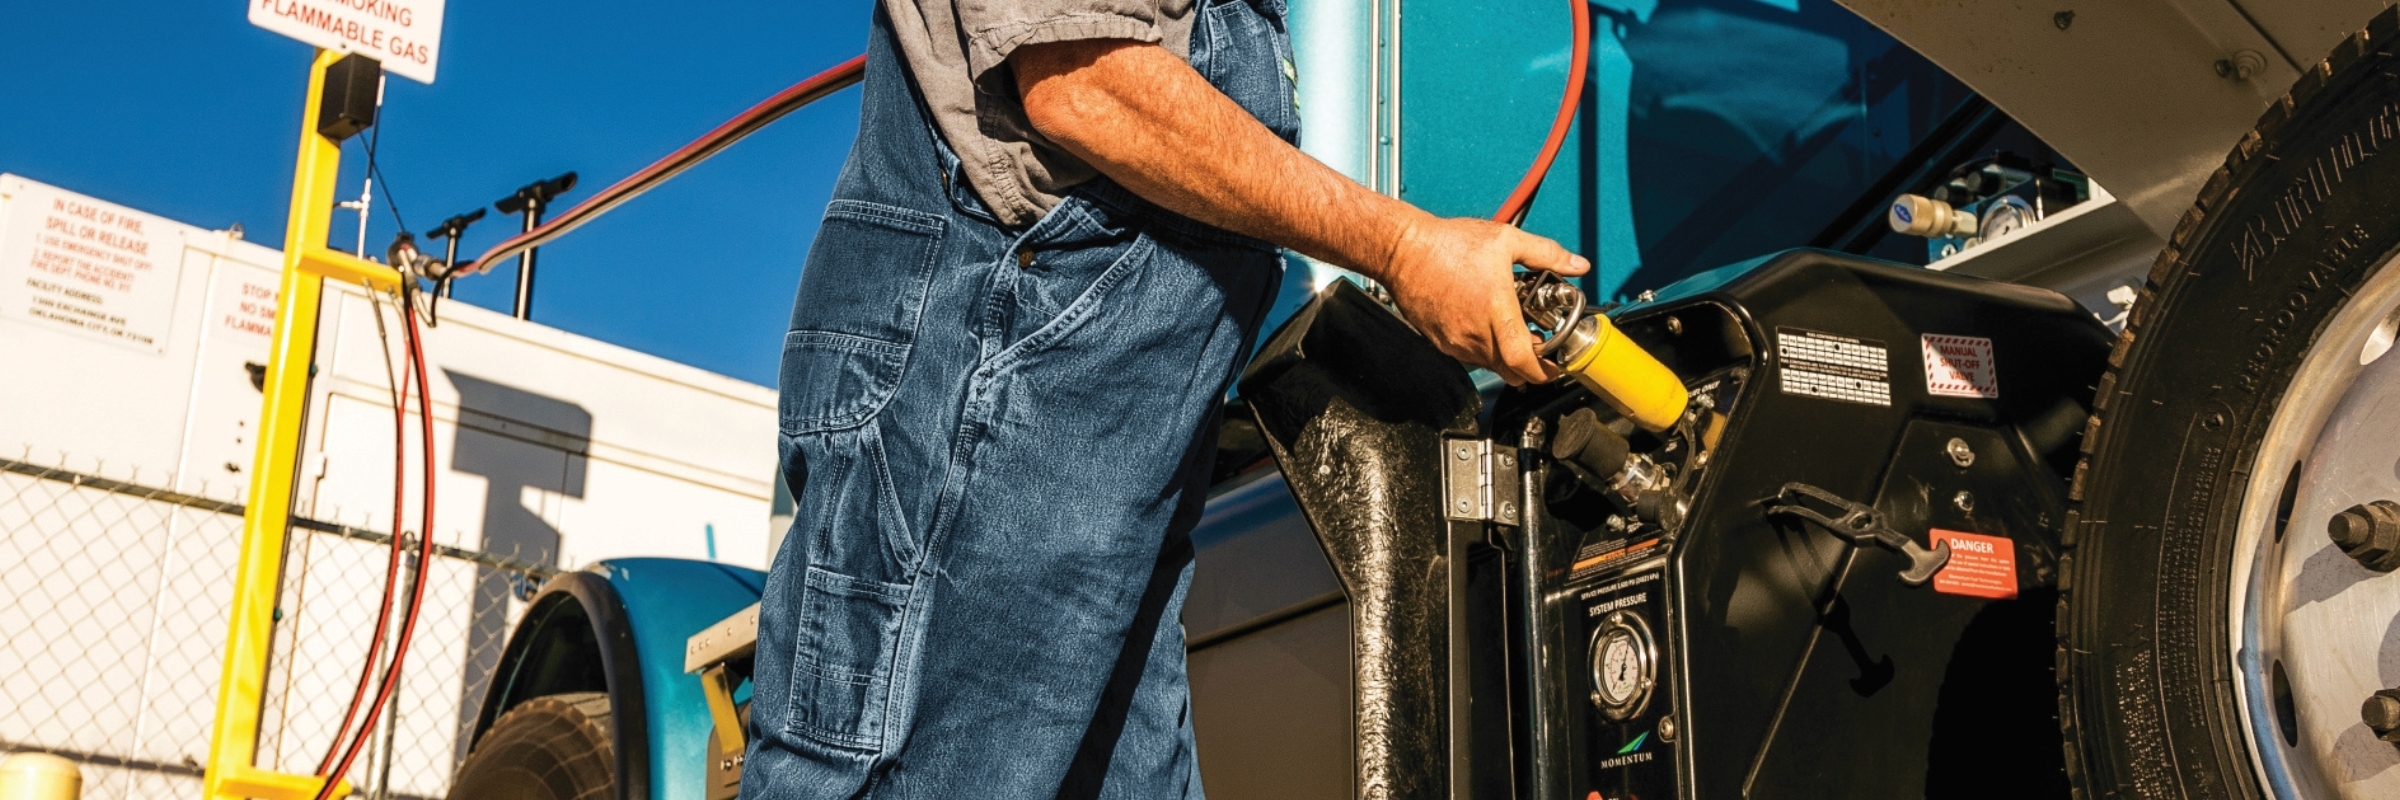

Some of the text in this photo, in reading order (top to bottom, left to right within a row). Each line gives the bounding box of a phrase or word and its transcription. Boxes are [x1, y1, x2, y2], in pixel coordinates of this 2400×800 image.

[388, 36, 429, 65] GAS
[53, 198, 65, 212] IN
[67, 201, 98, 222] CASE
[100, 211, 115, 225] OF
[45, 215, 149, 256] SPILL OR RELEASE
[42, 249, 74, 264] REPORT
[62, 240, 111, 260] EMERGENCY
[30, 258, 48, 270] FIRE
[26, 276, 62, 293] FACILITY
[242, 282, 272, 299] STOP
[240, 301, 257, 316] NO
[1939, 345, 1978, 357] MANUAL
[1940, 357, 1980, 370] SHUT-OFF
[1949, 370, 1975, 382] VALVE
[1950, 538, 1994, 554] DANGER
[1580, 590, 1597, 600] SERVICE
[1597, 583, 1617, 597] PRESSURE
[1589, 591, 1647, 617] SYSTEM PRESSURE
[1600, 751, 1653, 770] MOMENTUM
